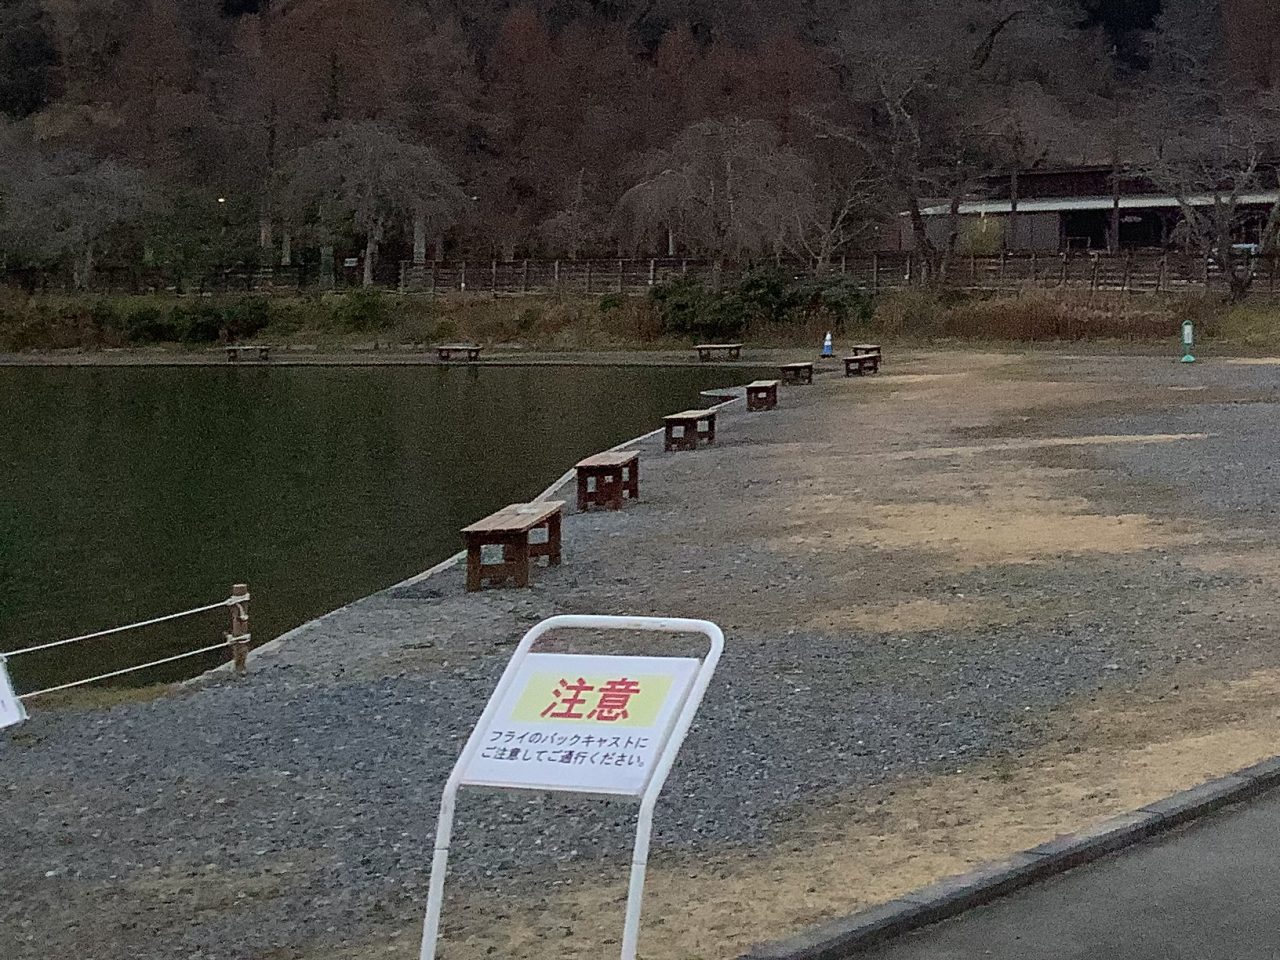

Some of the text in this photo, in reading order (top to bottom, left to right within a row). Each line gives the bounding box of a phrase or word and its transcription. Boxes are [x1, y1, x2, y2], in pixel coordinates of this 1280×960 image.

[540, 677, 640, 722] 注意
[490, 730, 648, 748] フライのバックキャストに
[481, 746, 645, 768] ご注意してご通行ください。
